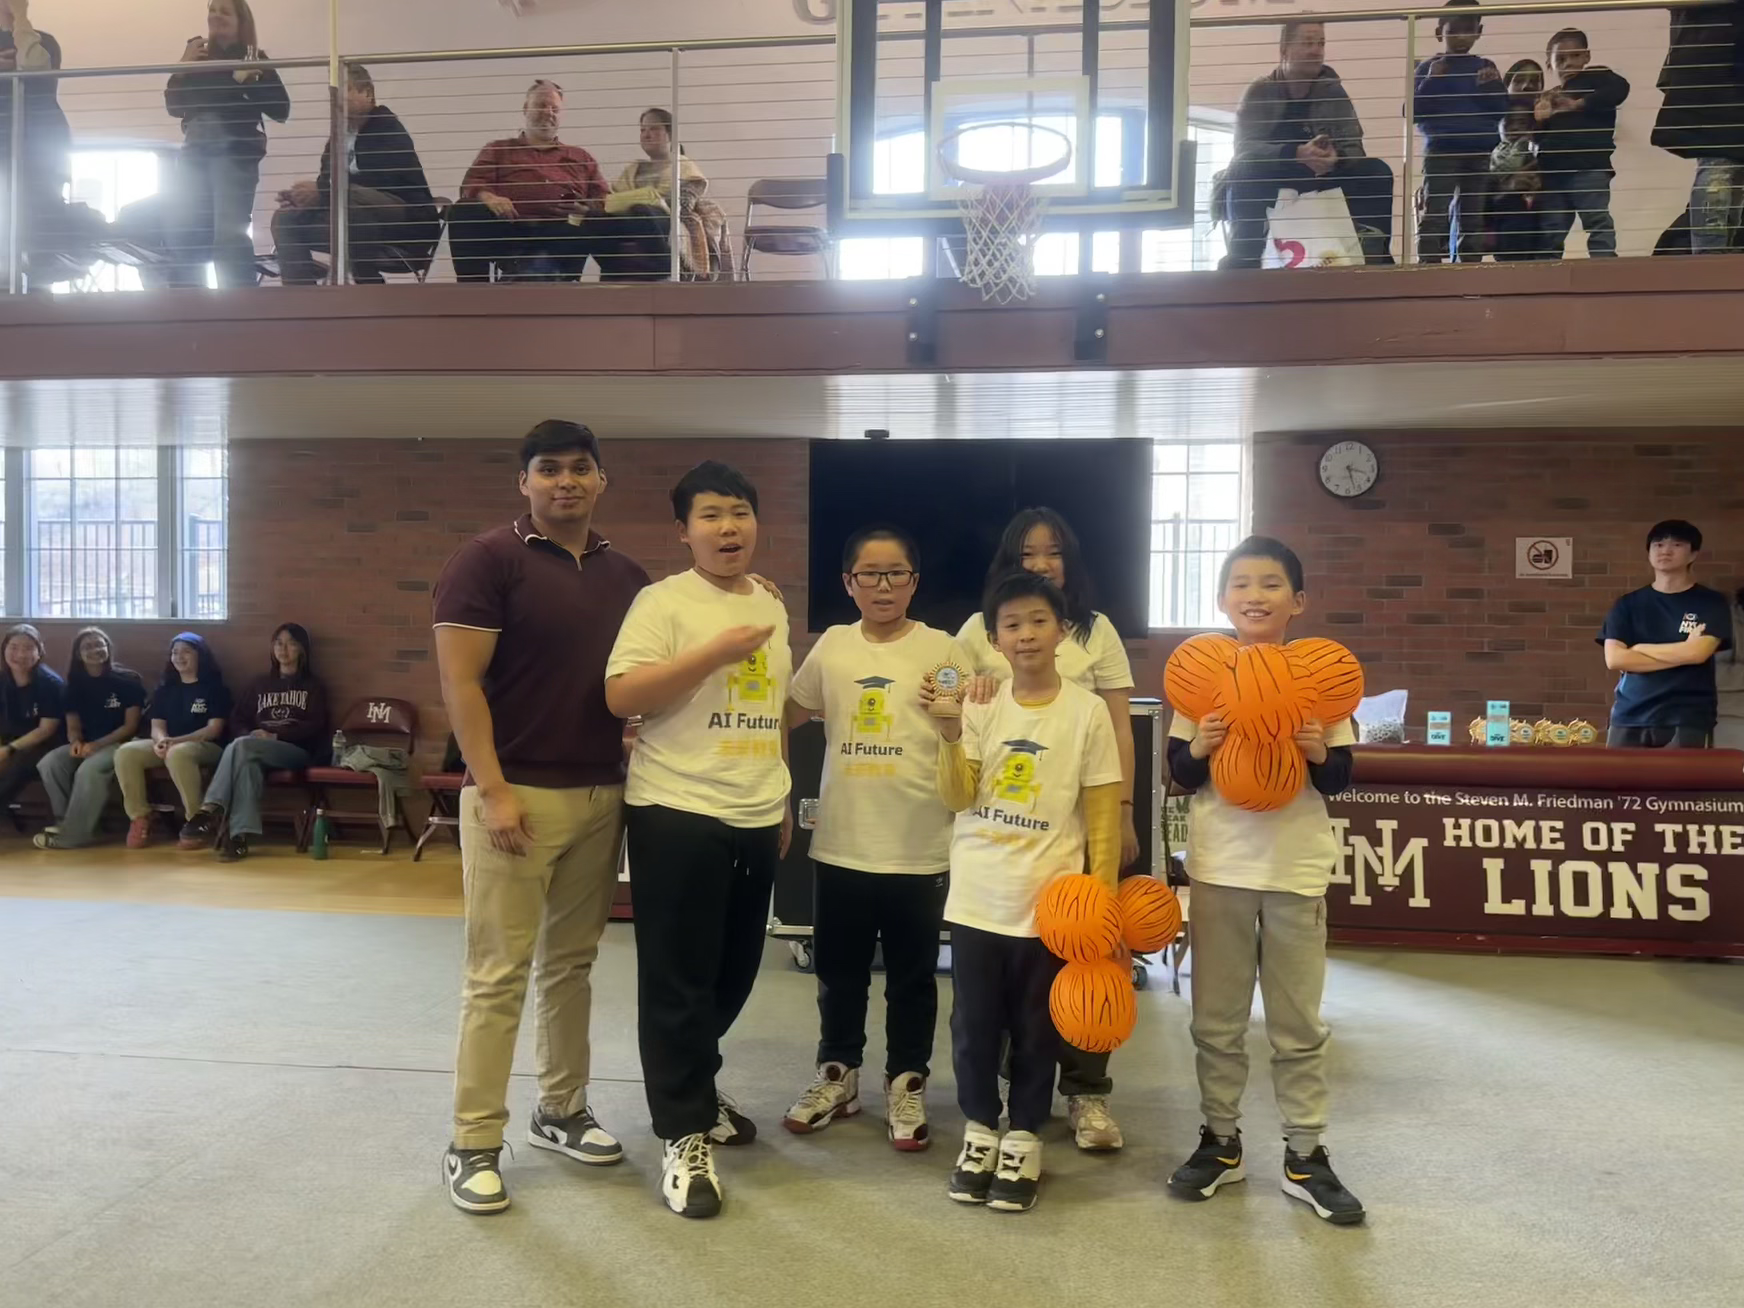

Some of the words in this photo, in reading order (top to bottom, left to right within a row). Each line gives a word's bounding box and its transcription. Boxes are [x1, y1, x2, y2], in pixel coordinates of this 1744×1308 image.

[257, 692, 280, 714] LAKE
[280, 690, 308, 710] TAHOE
[708, 712, 732, 729] AI
[737, 713, 780, 729] Futur
[841, 742, 853, 755] AI
[855, 742, 904, 756] Future
[1404, 791, 1421, 805] to
[1423, 791, 1452, 806] the
[1455, 791, 1509, 807] Steven
[1513, 793, 1533, 807] M.
[1537, 794, 1613, 809] Friedman
[1617, 795, 1642, 810] '72
[1646, 796, 1744, 814] Gymnasium
[993, 808, 1049, 831] Future
[1443, 818, 1565, 850] HOME
[1582, 821, 1636, 852] OF
[1654, 823, 1744, 856] THE
[1482, 857, 1711, 922] LIONS
